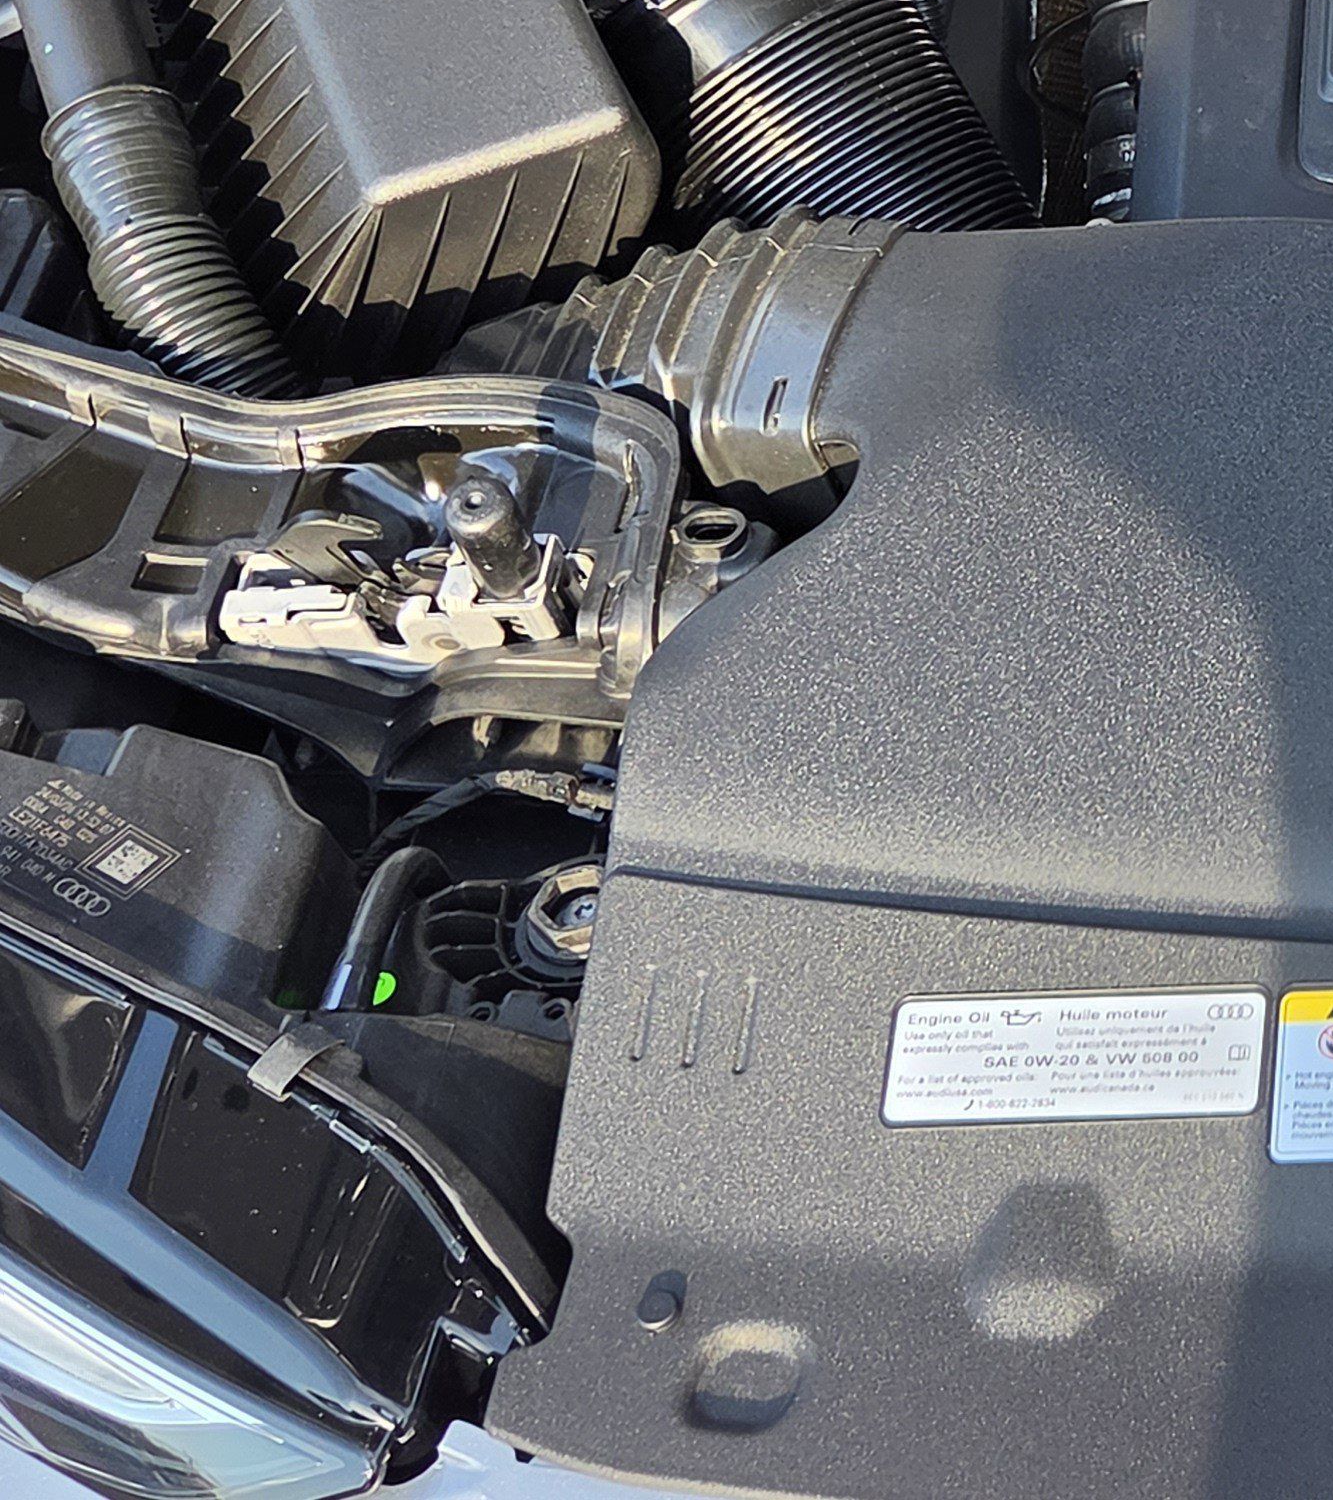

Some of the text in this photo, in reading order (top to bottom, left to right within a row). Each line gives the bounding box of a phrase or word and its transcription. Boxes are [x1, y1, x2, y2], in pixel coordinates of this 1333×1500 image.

[908, 1011, 990, 1027] Engine Oil
[1059, 1009, 1168, 1021] Huile moteur
[904, 1030, 993, 1041] Use only oil that
[903, 1042, 1029, 1054] expressly complies with
[984, 1056, 1019, 1068] SAE
[1024, 1054, 1080, 1067] 0W-20
[1085, 1054, 1098, 1065] &
[1106, 1053, 1136, 1064] VW
[1178, 1051, 1199, 1063] 00
[898, 1075, 916, 1084] For
[927, 1075, 944, 1083] list
[947, 1074, 959, 1083] of
[962, 1074, 1012, 1085] approved
